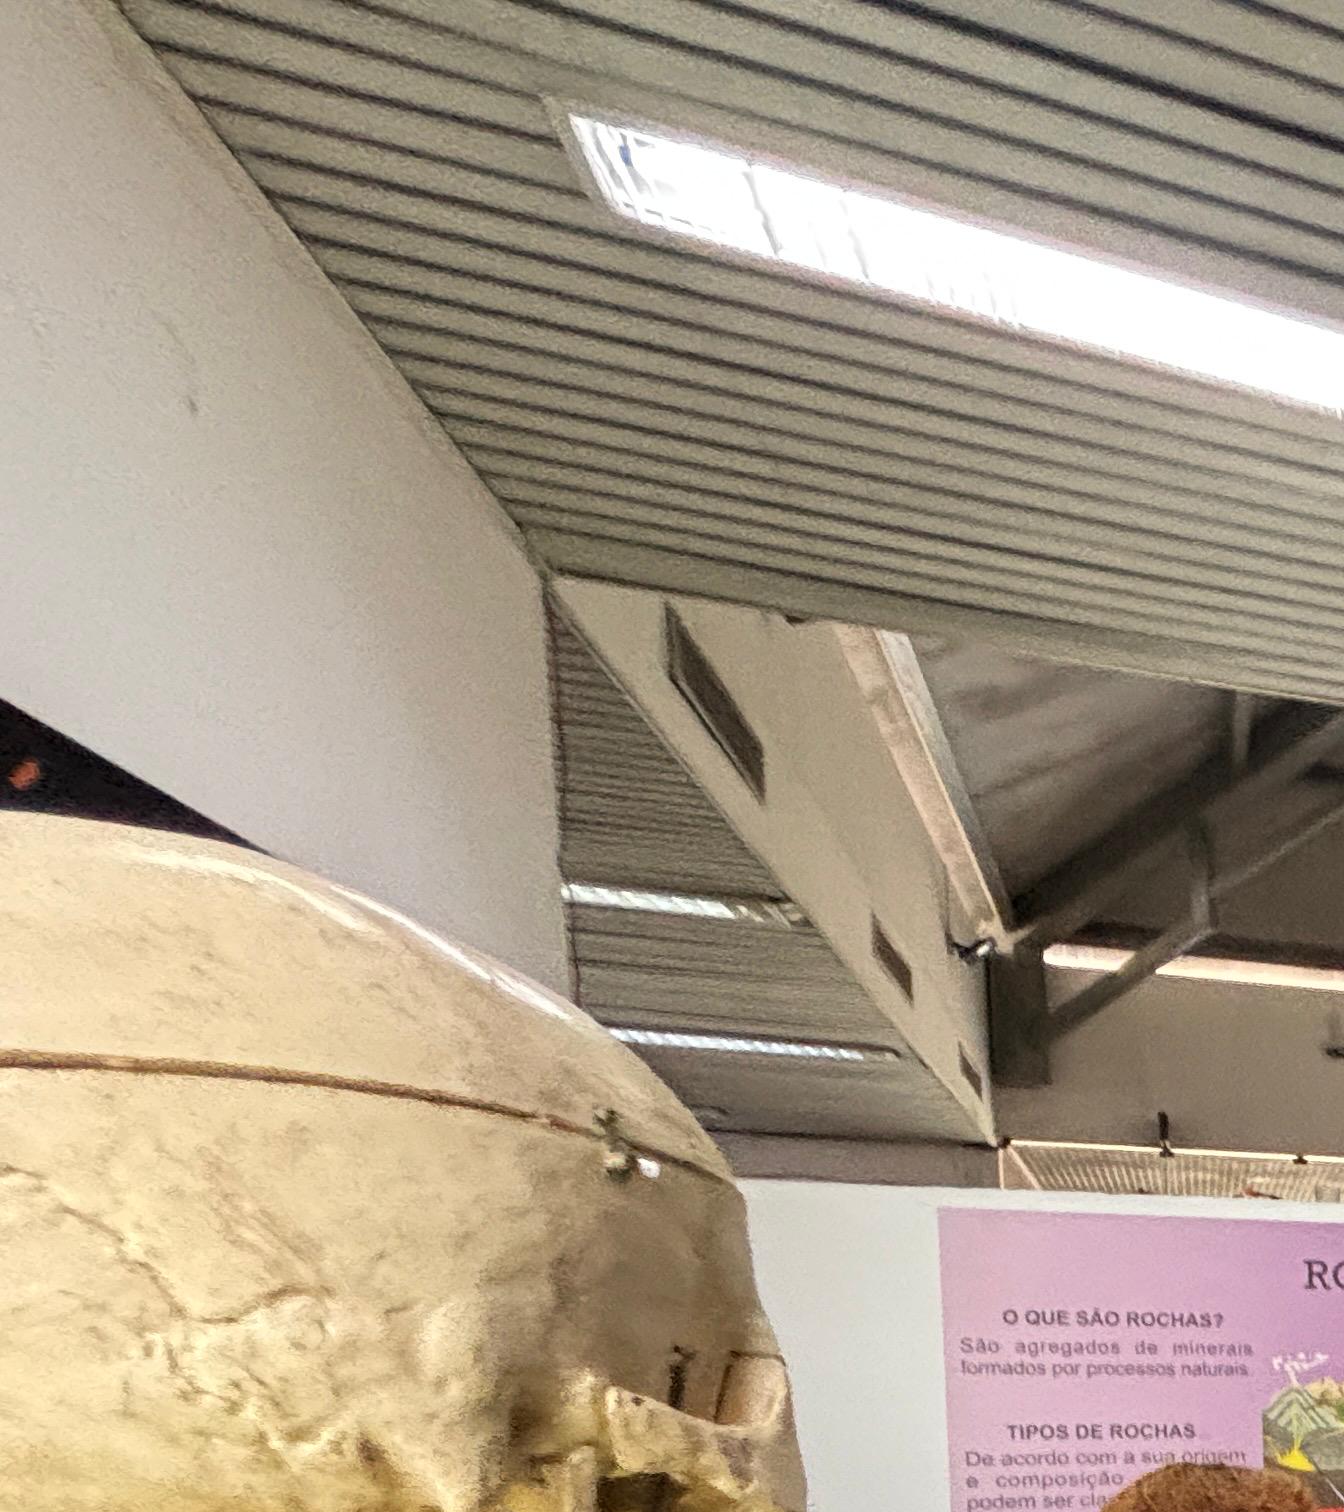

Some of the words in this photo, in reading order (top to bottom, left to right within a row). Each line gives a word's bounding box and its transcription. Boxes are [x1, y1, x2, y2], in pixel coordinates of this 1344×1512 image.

[1002, 1309, 1019, 1326] O
[1024, 1309, 1071, 1327] QUE
[1076, 1307, 1120, 1327] SÃO
[1126, 1311, 1225, 1329] ROCHAS?
[960, 1337, 1000, 1355] São
[1015, 1339, 1121, 1358] agregados
[1134, 1340, 1159, 1356] de
[1172, 1340, 1255, 1357] minerais
[960, 1359, 1047, 1377] formados
[1051, 1361, 1081, 1378] por
[1086, 1361, 1177, 1378] processos
[1180, 1361, 1250, 1377] naturais
[1007, 1424, 1070, 1441] TIPOS
[1076, 1424, 1103, 1440] DE
[1109, 1423, 1196, 1440] ROCHAS
[965, 1451, 994, 1467] De
[1001, 1449, 1070, 1467] acordo
[1075, 1452, 1118, 1465] com
[1141, 1450, 1176, 1465] sua
[1182, 1449, 1247, 1465] origem
[966, 1475, 979, 1489] e
[995, 1471, 1125, 1491] composição
[1042, 1495, 1075, 1510] ser
